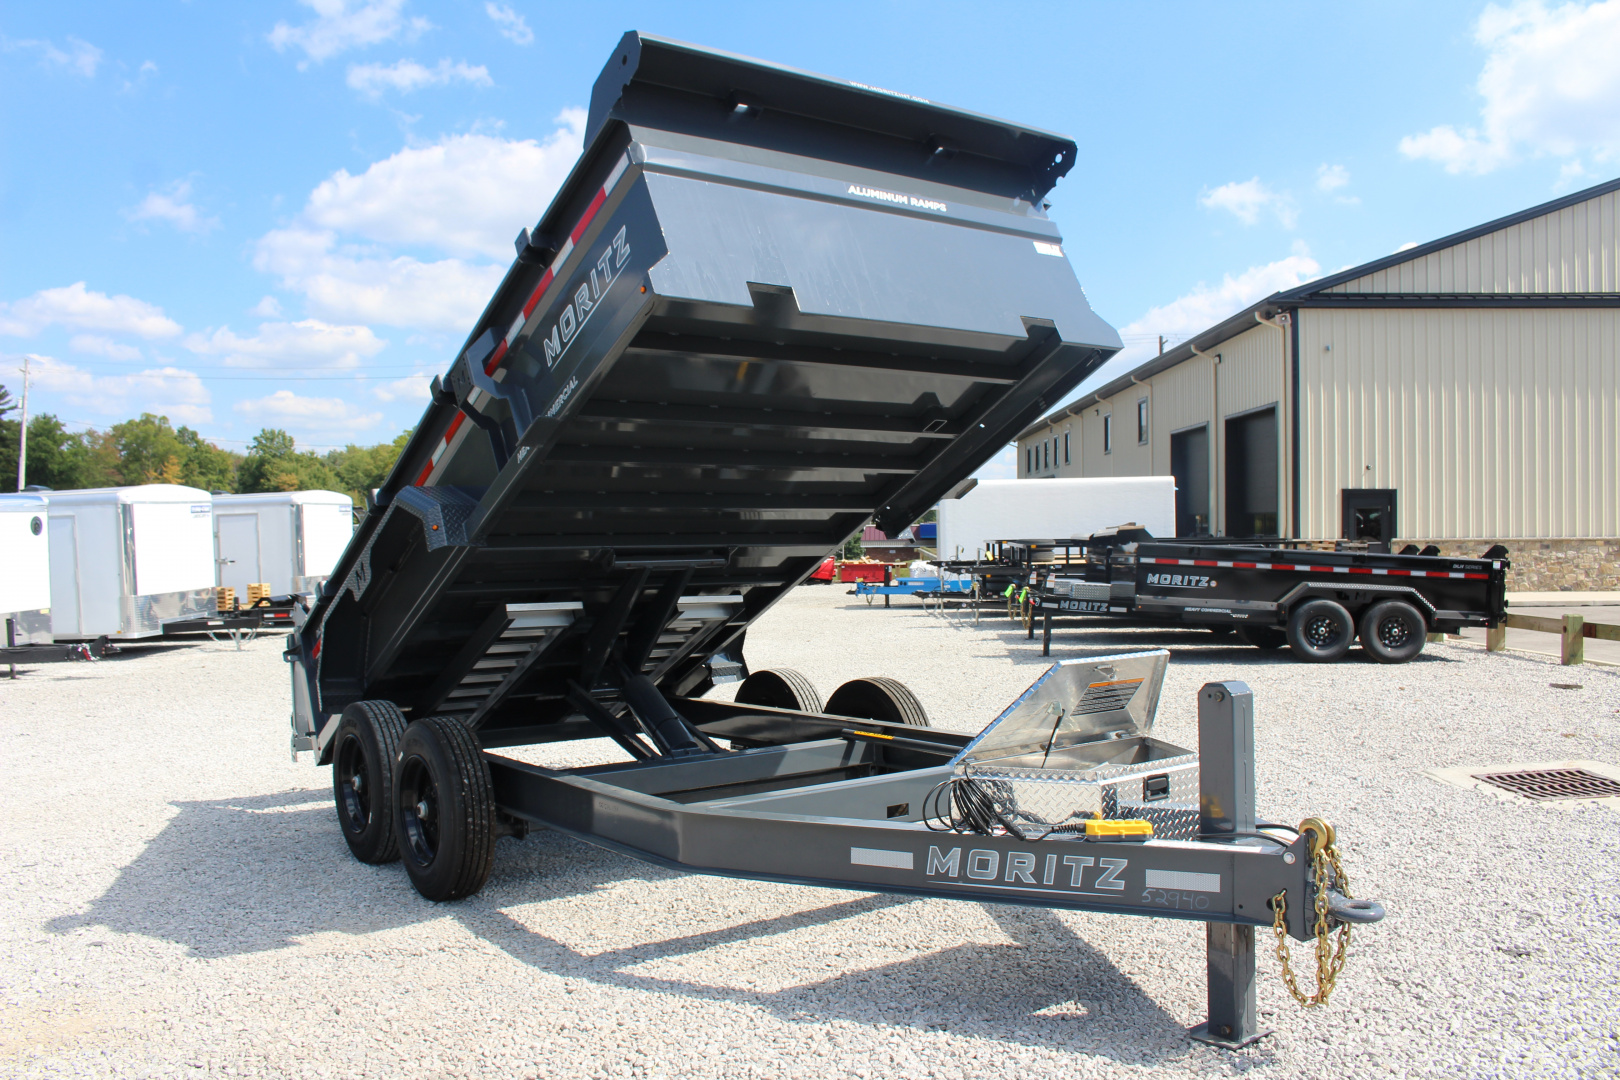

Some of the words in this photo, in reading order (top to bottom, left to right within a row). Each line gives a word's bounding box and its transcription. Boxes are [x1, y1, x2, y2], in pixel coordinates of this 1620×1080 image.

[848, 185, 908, 205] ALUMINUM
[911, 197, 947, 212] RAMPS
[543, 224, 631, 368] MORITZ
[1147, 573, 1210, 587] MORITZ
[1059, 600, 1109, 612] MORITZ
[925, 845, 1128, 891] MORITZ
[1141, 888, 1210, 910] 52940
